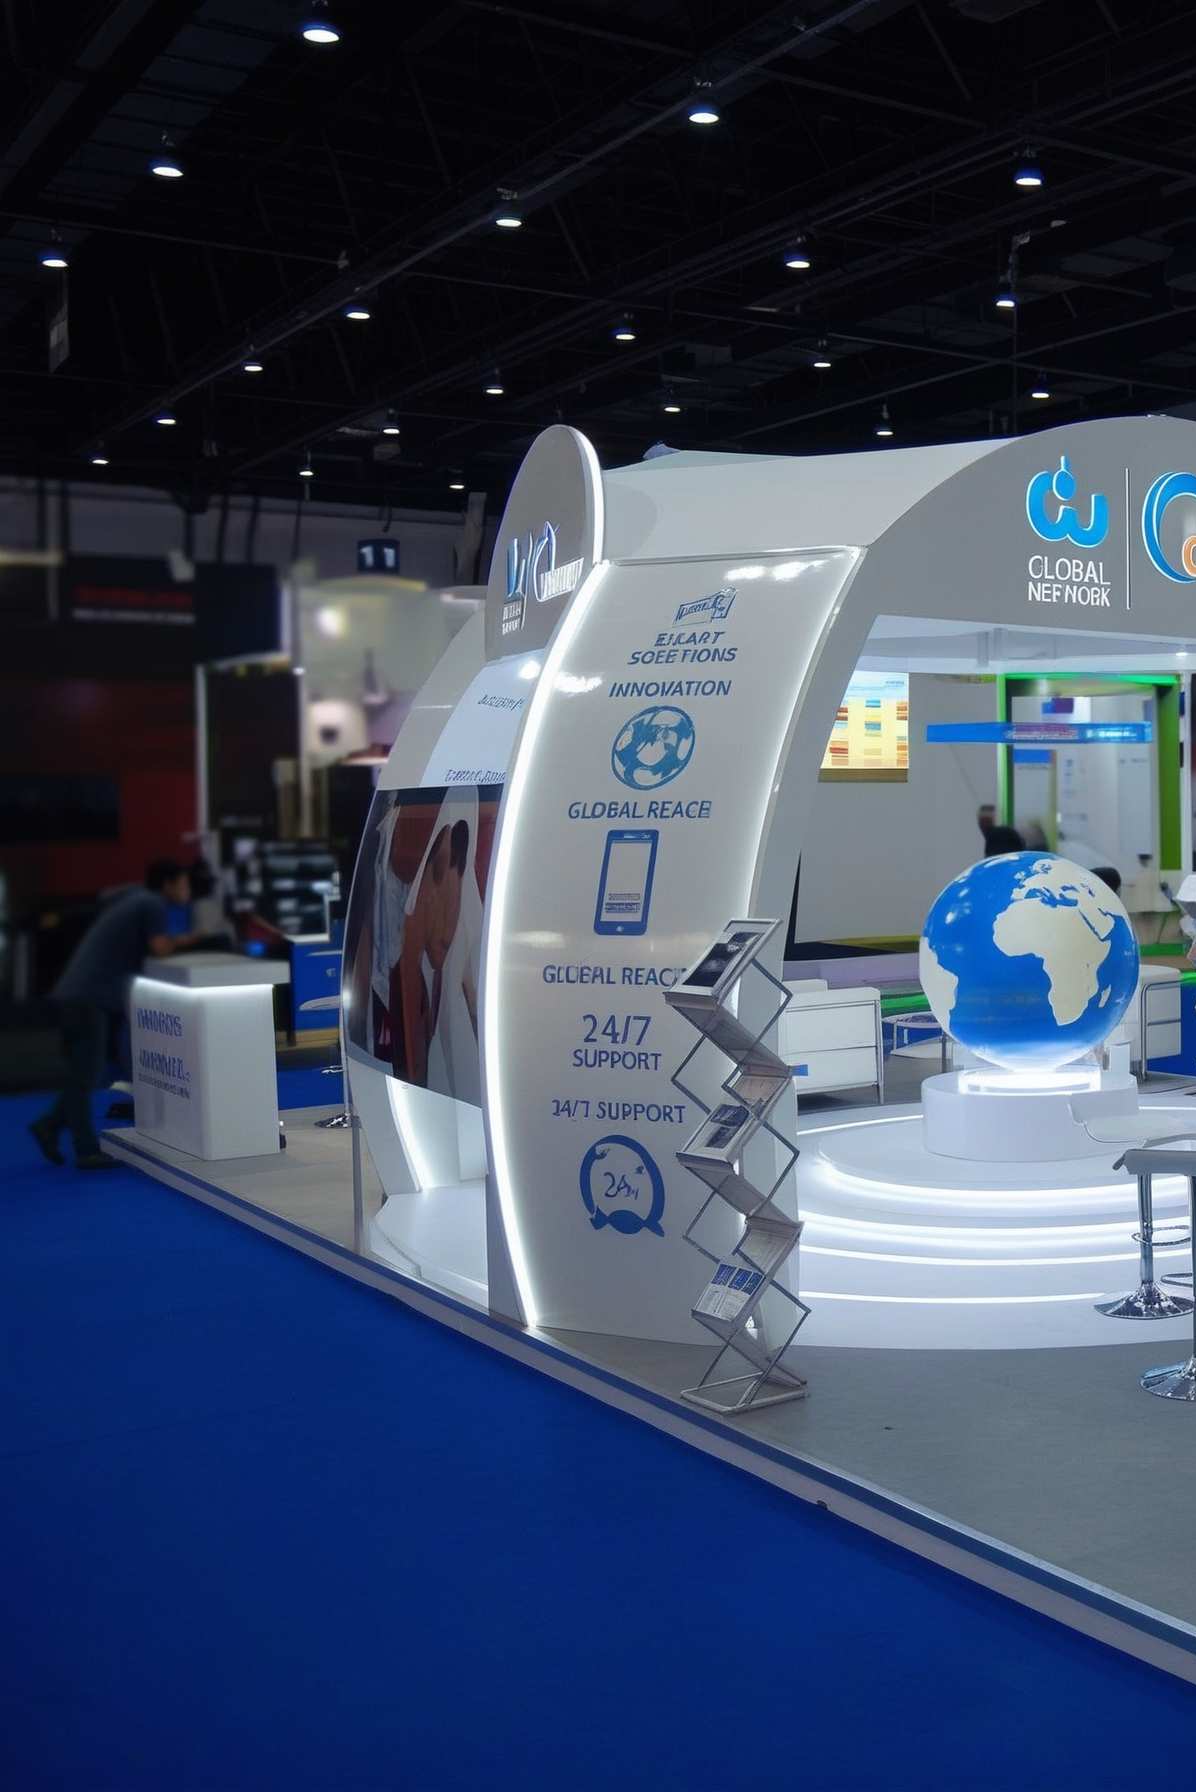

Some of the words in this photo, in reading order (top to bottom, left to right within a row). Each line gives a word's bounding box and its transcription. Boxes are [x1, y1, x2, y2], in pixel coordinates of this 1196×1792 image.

[1028, 554, 1111, 585] GLOBAL
[608, 680, 732, 698] INNOVATION
[583, 1014, 652, 1046] 24/7
[572, 1049, 662, 1071] SUPPORT
[596, 1101, 686, 1123] SUPPORT
